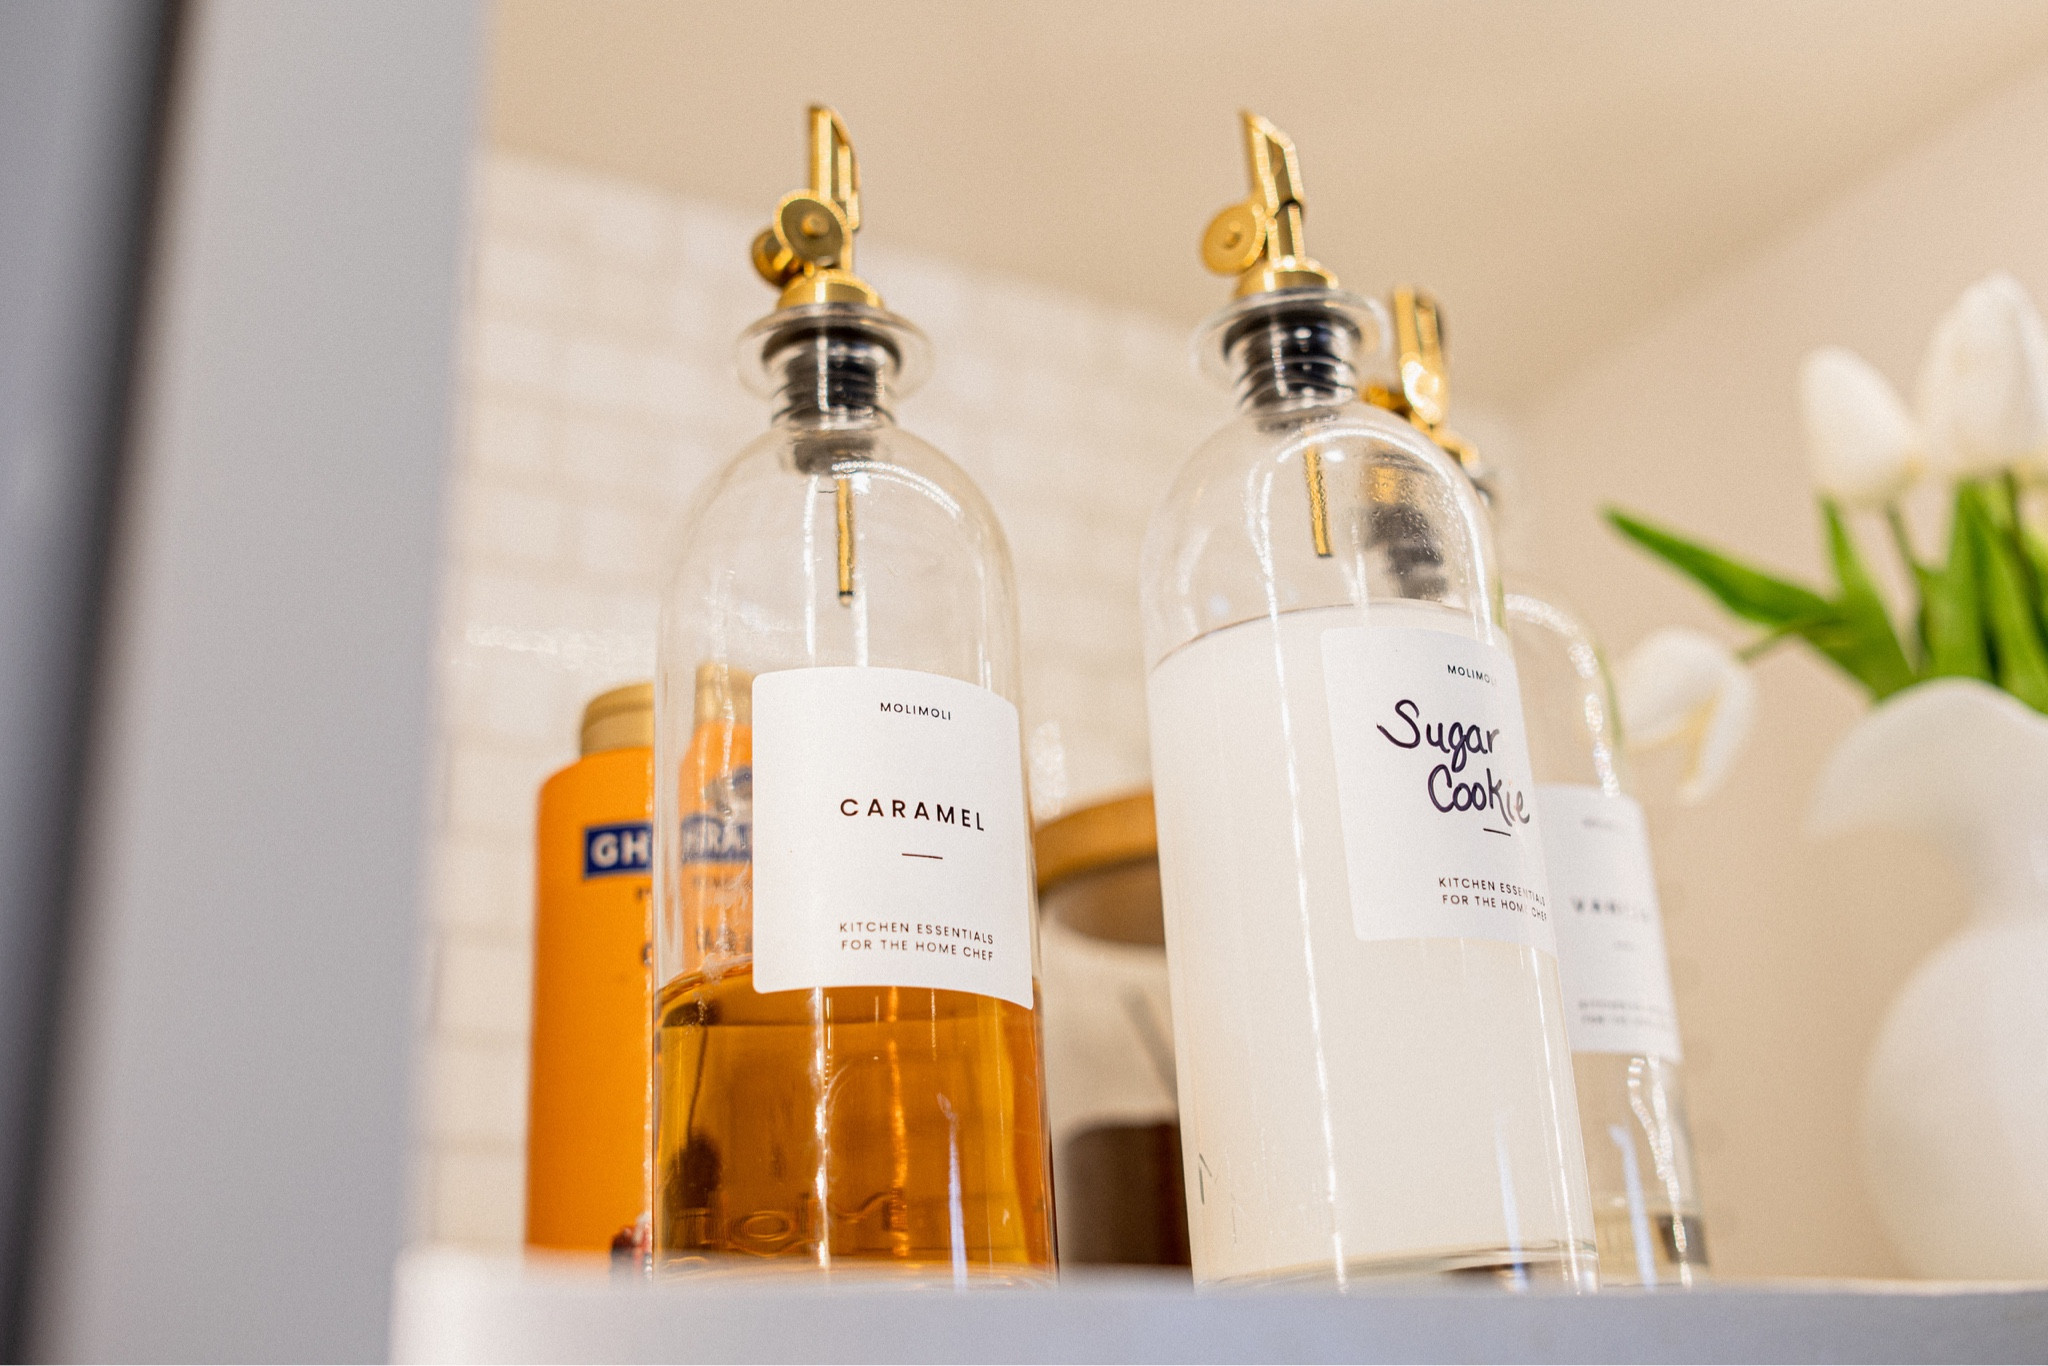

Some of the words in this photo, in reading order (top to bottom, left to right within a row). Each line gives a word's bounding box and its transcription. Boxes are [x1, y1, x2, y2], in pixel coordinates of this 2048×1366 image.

[1447, 664, 1497, 686] MOLIMO
[880, 702, 951, 721] MOLIMOLI
[1376, 699, 1500, 773] Sugar
[1427, 763, 1530, 828] Cookie
[840, 798, 985, 832] CARAMEL
[1438, 877, 1496, 892] KITCHEN
[1442, 894, 1469, 906] FOR
[1474, 895, 1497, 908] THE
[1501, 900, 1528, 914] HOM
[839, 921, 910, 934] KITCHEN
[917, 923, 994, 945] ESSENTIALS
[841, 939, 872, 951] FOR
[880, 939, 908, 951] THE
[915, 941, 957, 956] HOME
[962, 946, 994, 962] CHEF
